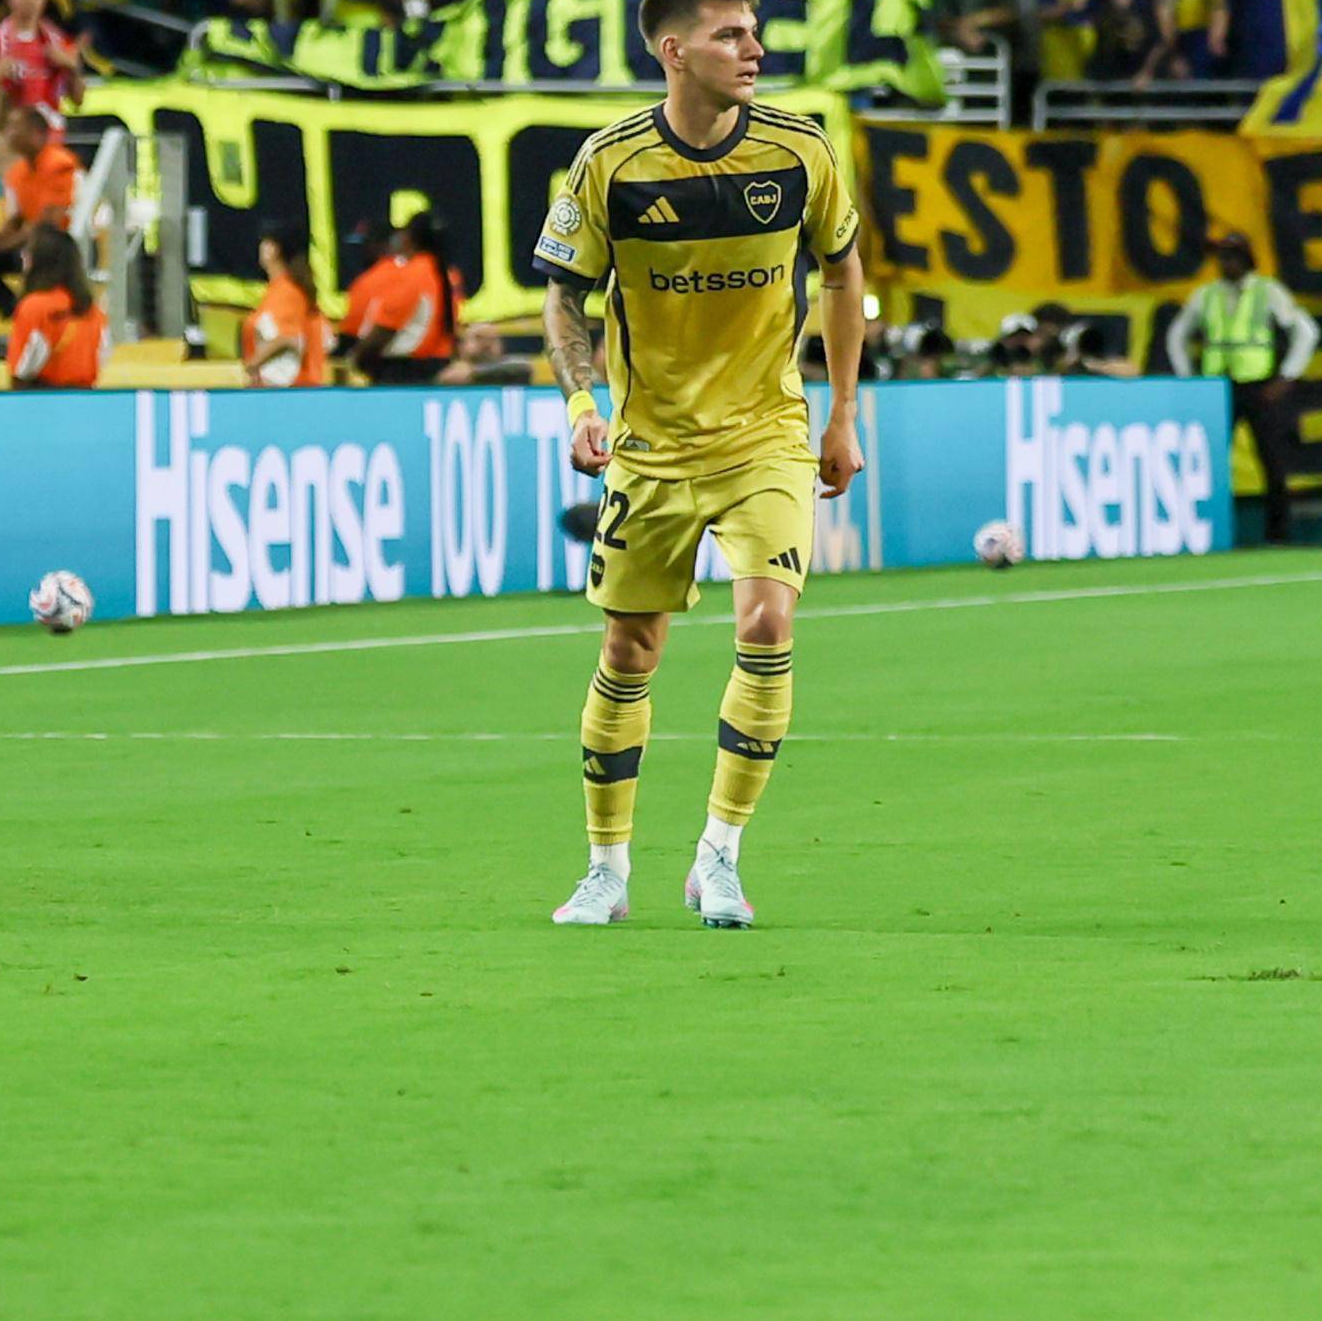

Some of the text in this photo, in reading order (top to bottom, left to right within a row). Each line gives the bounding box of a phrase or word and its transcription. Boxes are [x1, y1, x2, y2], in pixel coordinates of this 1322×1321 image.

[649, 262, 785, 295] betsson
[878, 127, 1206, 282] ESTO
[135, 390, 405, 617] Hisense
[1005, 376, 1212, 562] Hisense
